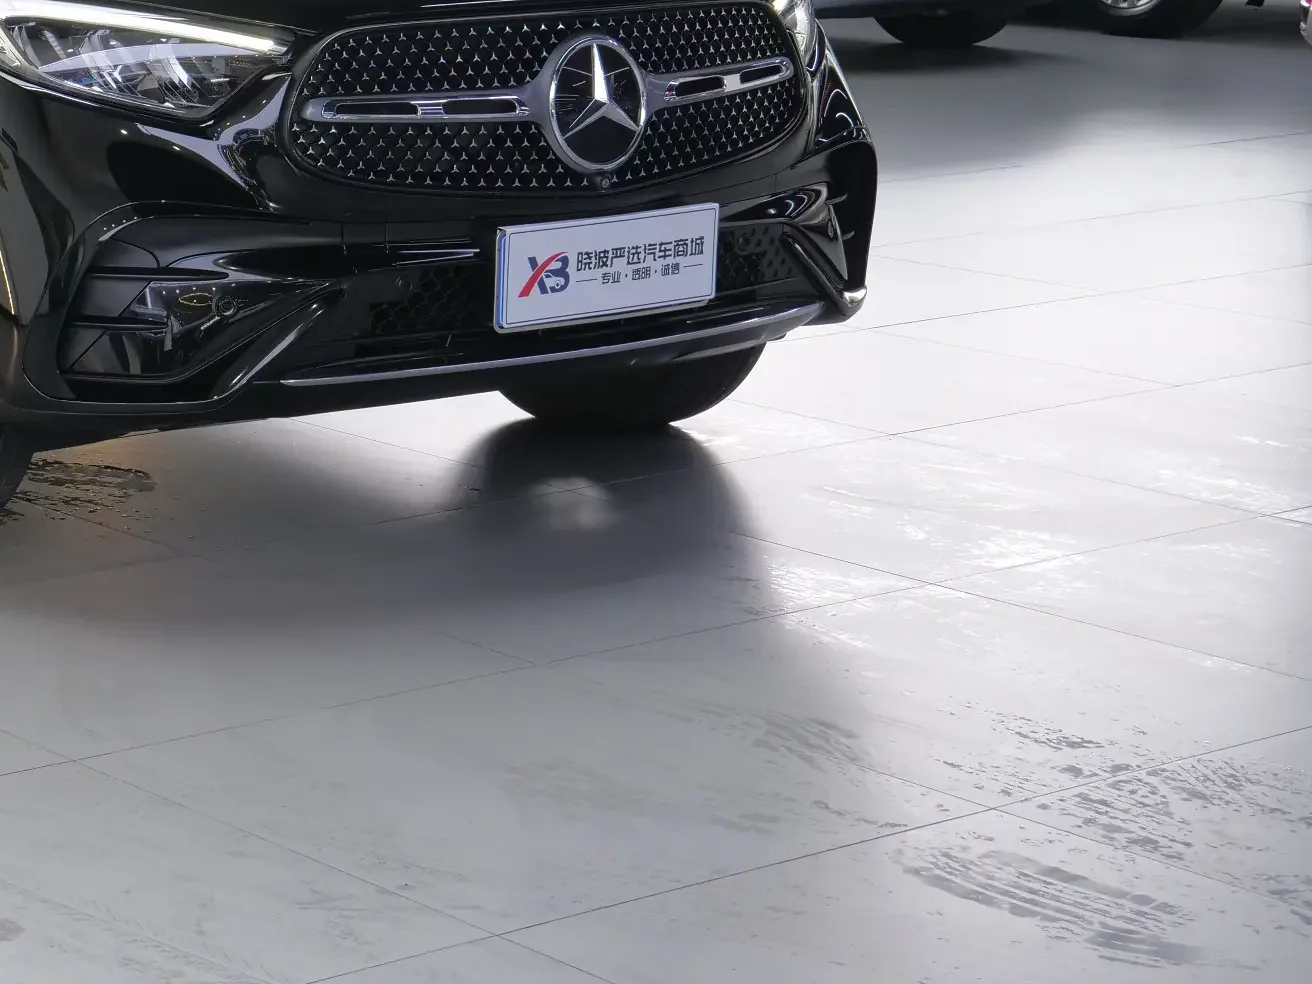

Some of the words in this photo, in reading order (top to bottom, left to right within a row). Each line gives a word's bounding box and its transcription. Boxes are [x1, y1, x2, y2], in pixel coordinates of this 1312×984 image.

[576, 235, 705, 272] 晓波严选汽车商城
